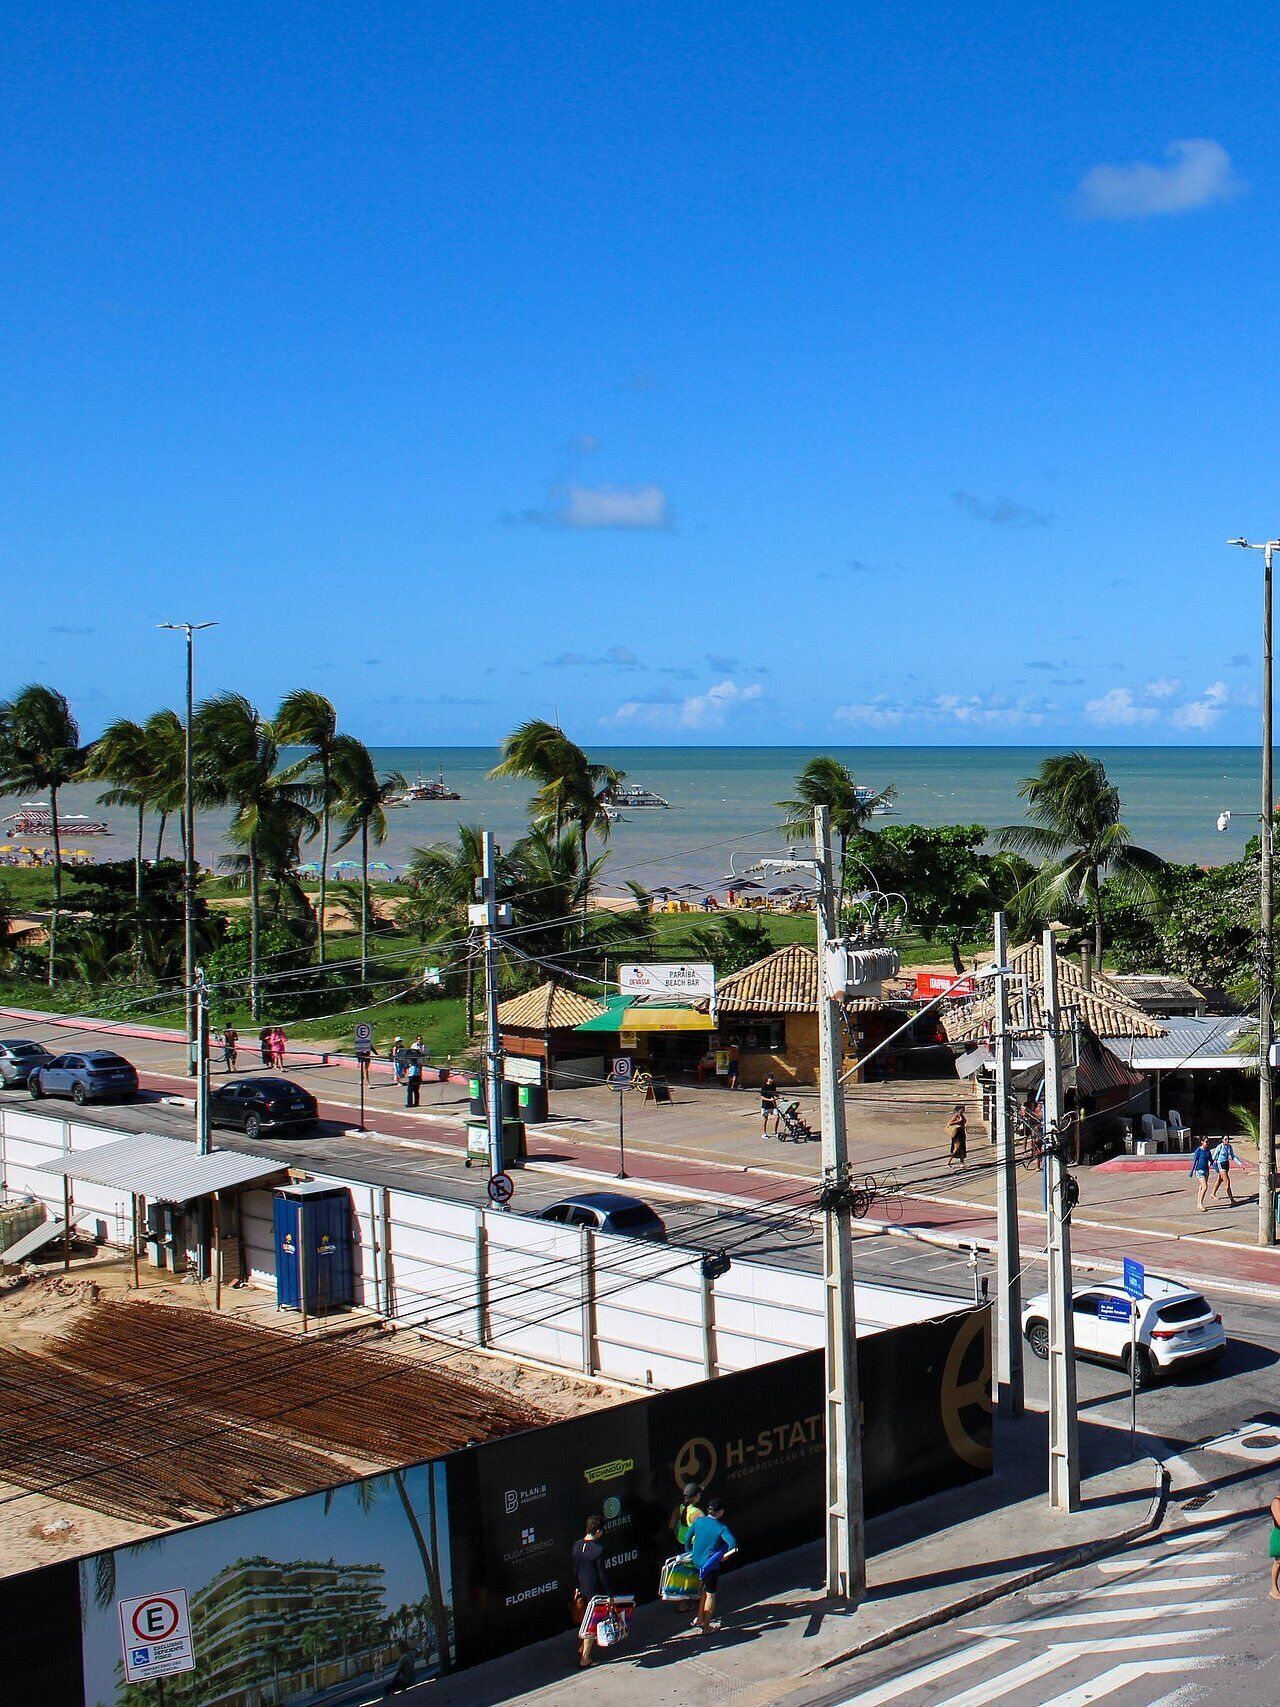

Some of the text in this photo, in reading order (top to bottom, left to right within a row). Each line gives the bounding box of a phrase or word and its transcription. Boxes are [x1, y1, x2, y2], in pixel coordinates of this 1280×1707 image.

[669, 970, 696, 979] PARAÍBA
[629, 978, 650, 986] DEVASSA
[665, 979, 700, 987] BEACH BAR
[587, 1460, 632, 1481] TECHNOGYM
[505, 1580, 559, 1607] FLORENSE
[146, 1606, 165, 1633] E
[153, 1640, 184, 1652] EXCLUSIVO
